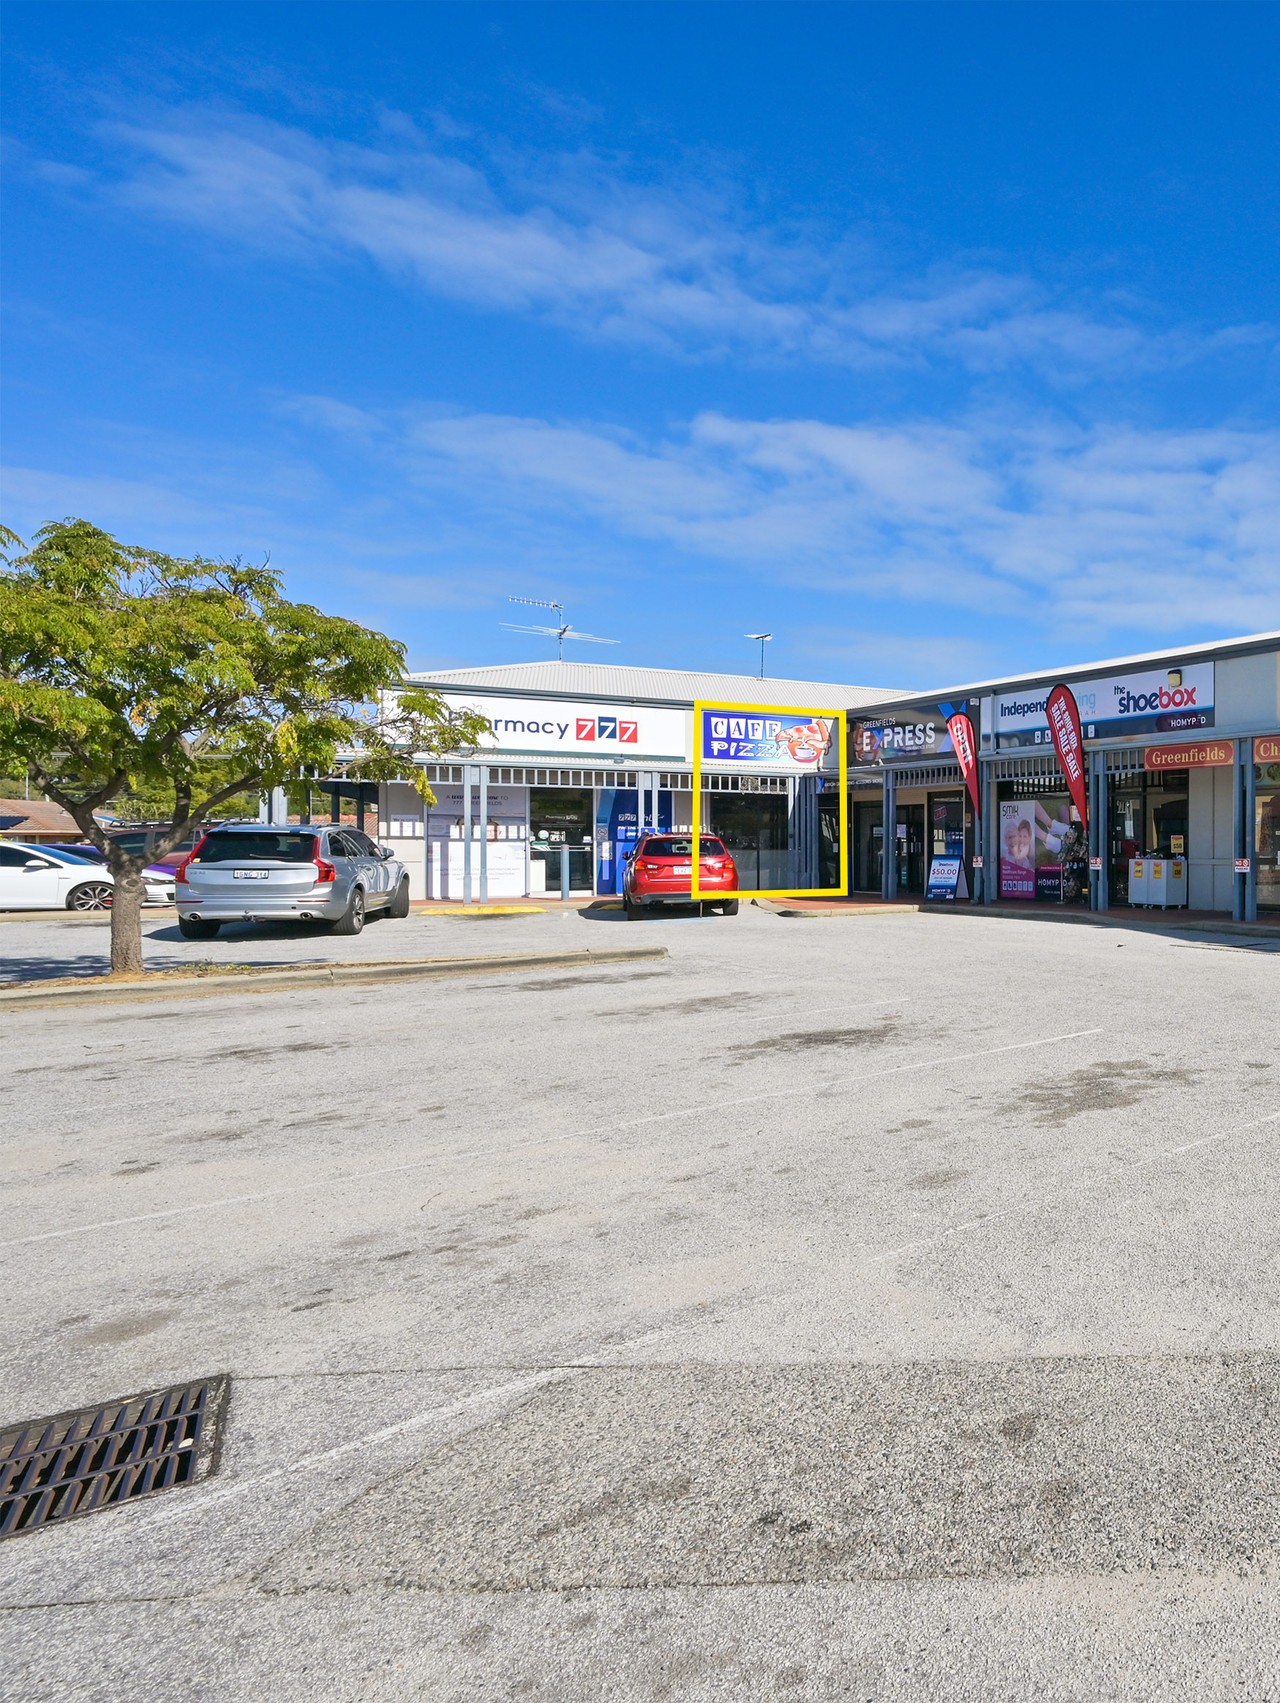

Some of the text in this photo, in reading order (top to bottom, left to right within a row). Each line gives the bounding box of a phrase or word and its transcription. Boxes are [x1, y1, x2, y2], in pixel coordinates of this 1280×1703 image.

[1113, 685, 1126, 695] the
[1118, 686, 1197, 714] shoebox
[1000, 697, 1048, 717] Independ
[577, 718, 637, 742] 777
[711, 718, 782, 740] CAFE
[863, 718, 896, 729] GREENFIELDS
[863, 722, 936, 751] EXPRESS
[953, 723, 973, 763] OPEN
[1051, 703, 1080, 781] SALE SALE SALE
[710, 740, 793, 760] PIZZA
[1152, 746, 1226, 765] Greenfields
[931, 868, 957, 876] $50.00
[1037, 879, 1068, 887] HOMYPD
